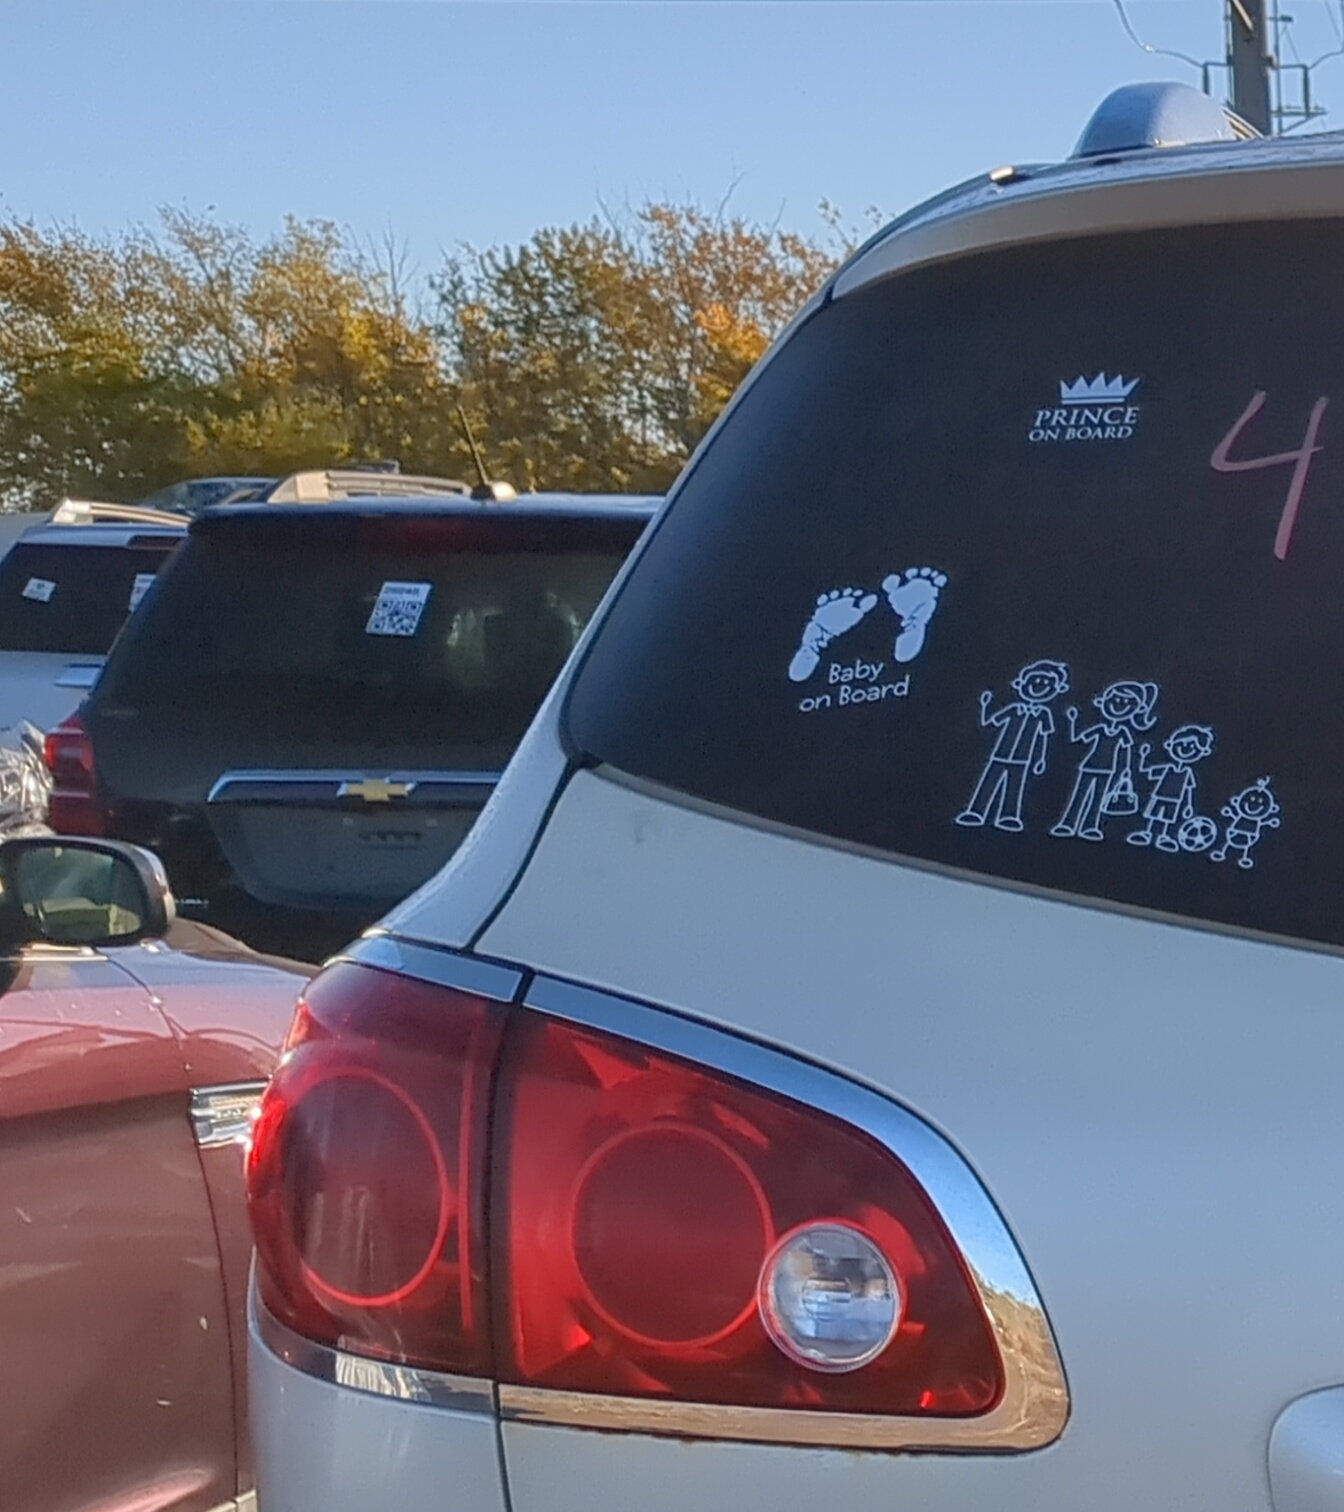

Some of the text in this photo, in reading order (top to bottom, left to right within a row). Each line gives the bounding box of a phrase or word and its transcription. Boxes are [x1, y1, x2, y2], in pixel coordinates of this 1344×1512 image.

[1034, 406, 1140, 427] PRINCE
[1028, 426, 1133, 442] ON BOARD
[828, 659, 884, 684] Baby
[799, 674, 911, 712] on Board
